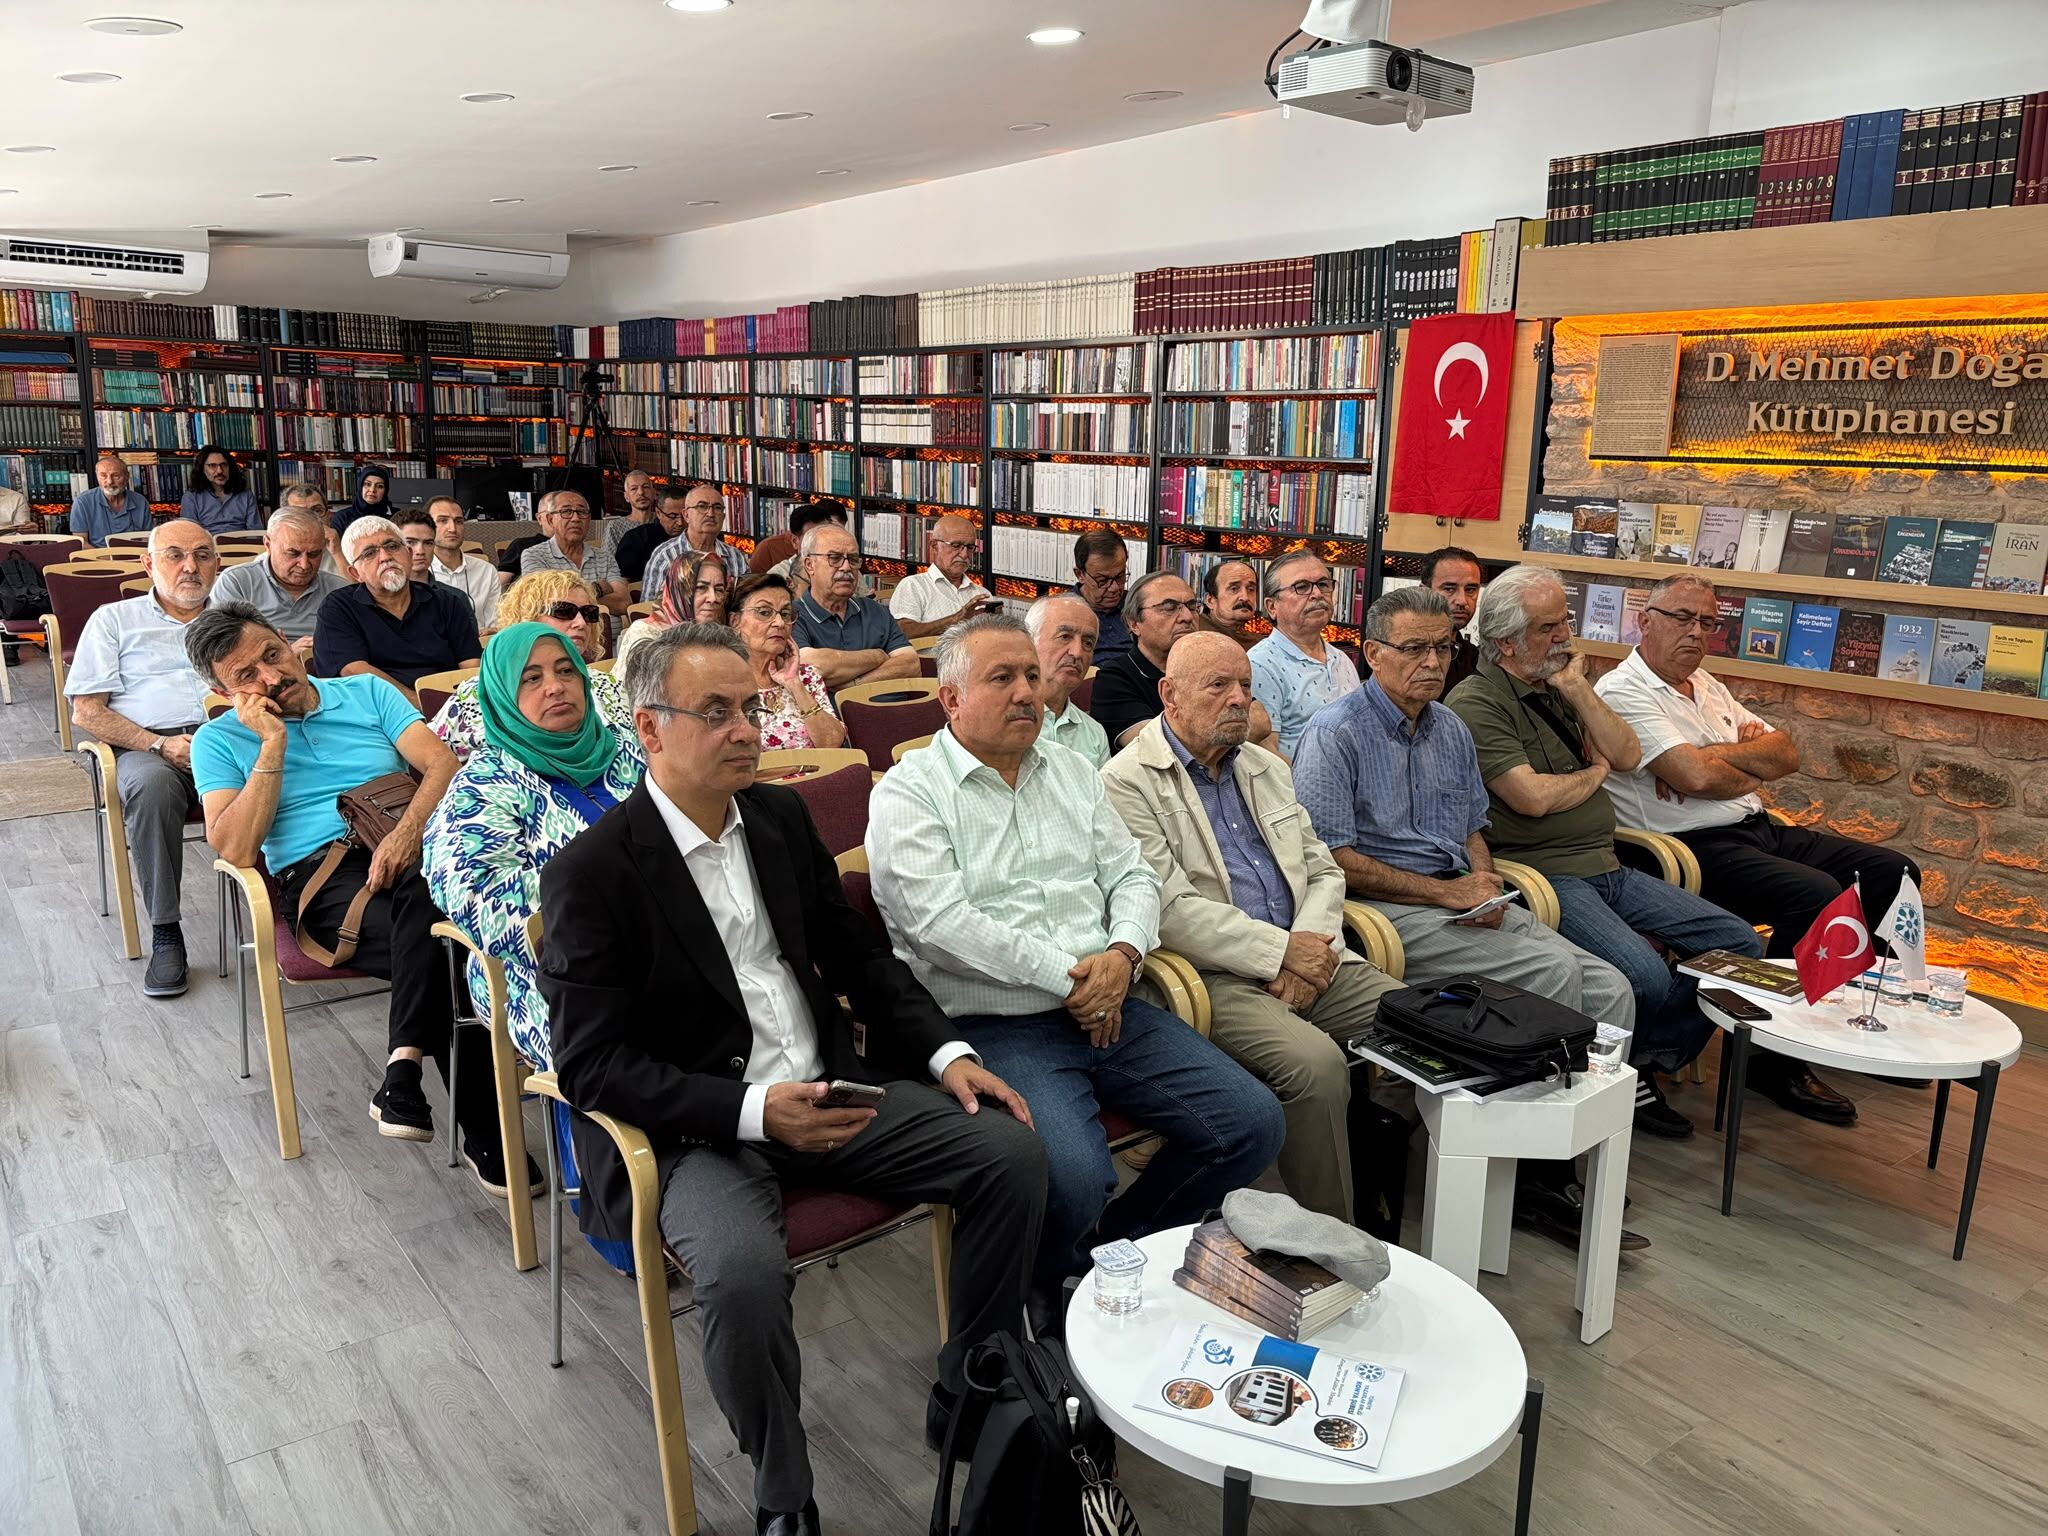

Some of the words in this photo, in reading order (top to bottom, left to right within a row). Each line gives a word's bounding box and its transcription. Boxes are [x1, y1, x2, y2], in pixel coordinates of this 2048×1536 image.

[1787, 180, 1793, 193] 4
[1796, 179, 1803, 192] 5
[1806, 178, 1813, 190] 6
[1817, 176, 1823, 189] 7
[1826, 174, 1833, 188] 8
[1759, 183, 1764, 195] 1
[1768, 182, 1774, 194] 2
[1778, 181, 1784, 194] 3
[1705, 352, 1739, 382] D.
[1746, 350, 1915, 382] Mehmet
[1746, 401, 2017, 440] Kütüphanesi
[1662, 513, 1678, 521] Devlet
[2005, 536, 2040, 551] İRAN
[1798, 612, 1832, 621] Kelimelerin
[1812, 620, 1832, 628] Defteri
[1899, 624, 1922, 634] 1932
[1848, 640, 1879, 651] Yüzyılın
[1840, 647, 1878, 658] Soykırımı
